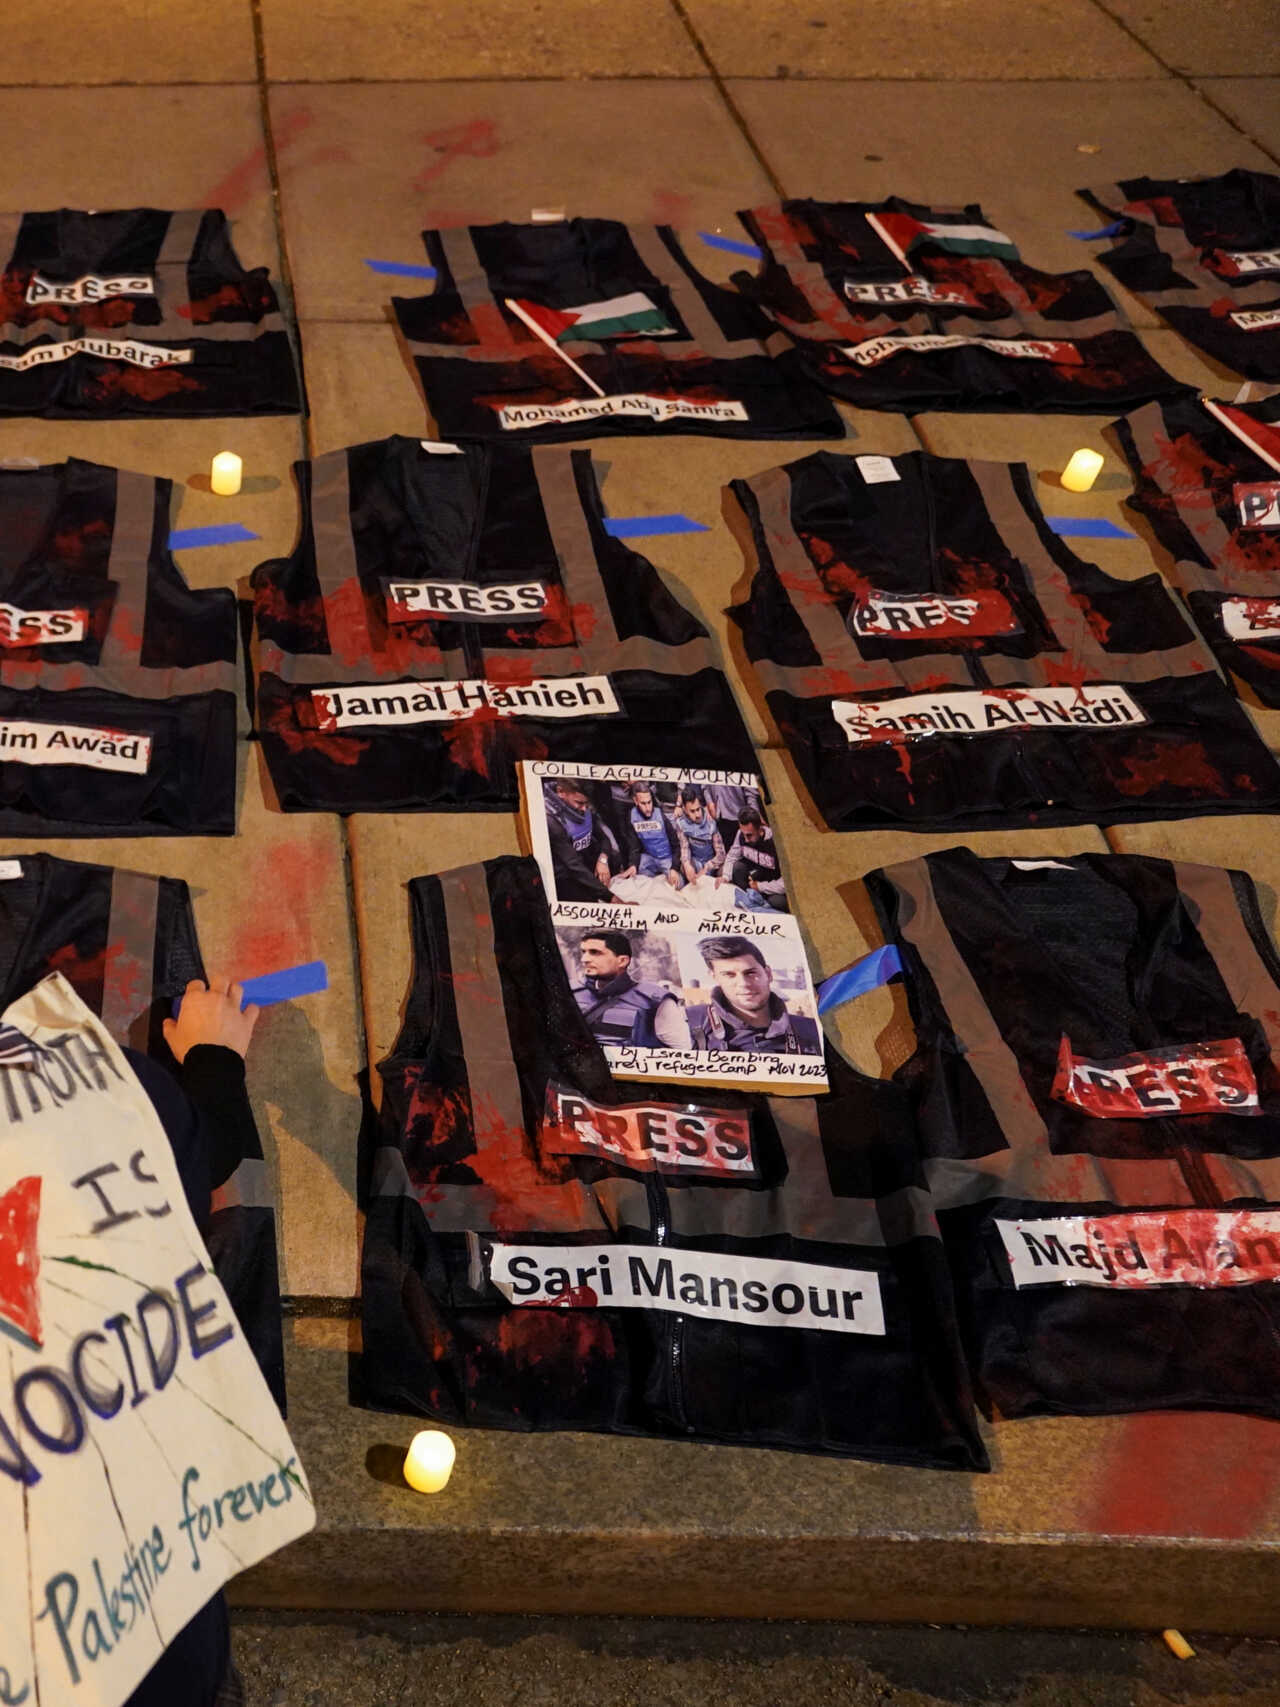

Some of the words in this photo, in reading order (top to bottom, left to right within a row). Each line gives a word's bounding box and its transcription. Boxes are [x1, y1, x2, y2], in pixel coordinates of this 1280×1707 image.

[61, 340, 183, 368] Mubarak
[504, 401, 614, 423] Mohamed
[394, 586, 545, 612] PRESS
[856, 603, 990, 631] PRES
[331, 686, 447, 717] Jamal
[457, 682, 605, 709] Hanieh
[847, 704, 974, 736] Samih
[986, 697, 1135, 727] Al-Nadi
[47, 730, 140, 760] Awad
[532, 760, 668, 780] COLLEAGUES
[678, 767, 752, 787] MOURN
[591, 917, 648, 932] SALIM
[697, 922, 785, 937] MANSOUR
[654, 911, 679, 924] AND
[703, 911, 756, 925] SARI
[620, 1045, 637, 1063] by
[646, 1047, 698, 1060] Israel
[708, 1048, 780, 1067] Bombing
[656, 1060, 719, 1075] refugee
[561, 1098, 749, 1160] PRESS
[71, 1149, 173, 1234] IS
[1020, 1229, 1149, 1281] Majd
[507, 1254, 613, 1297] Sari
[628, 1256, 863, 1320] Mansour
[179, 1456, 299, 1573] forever
